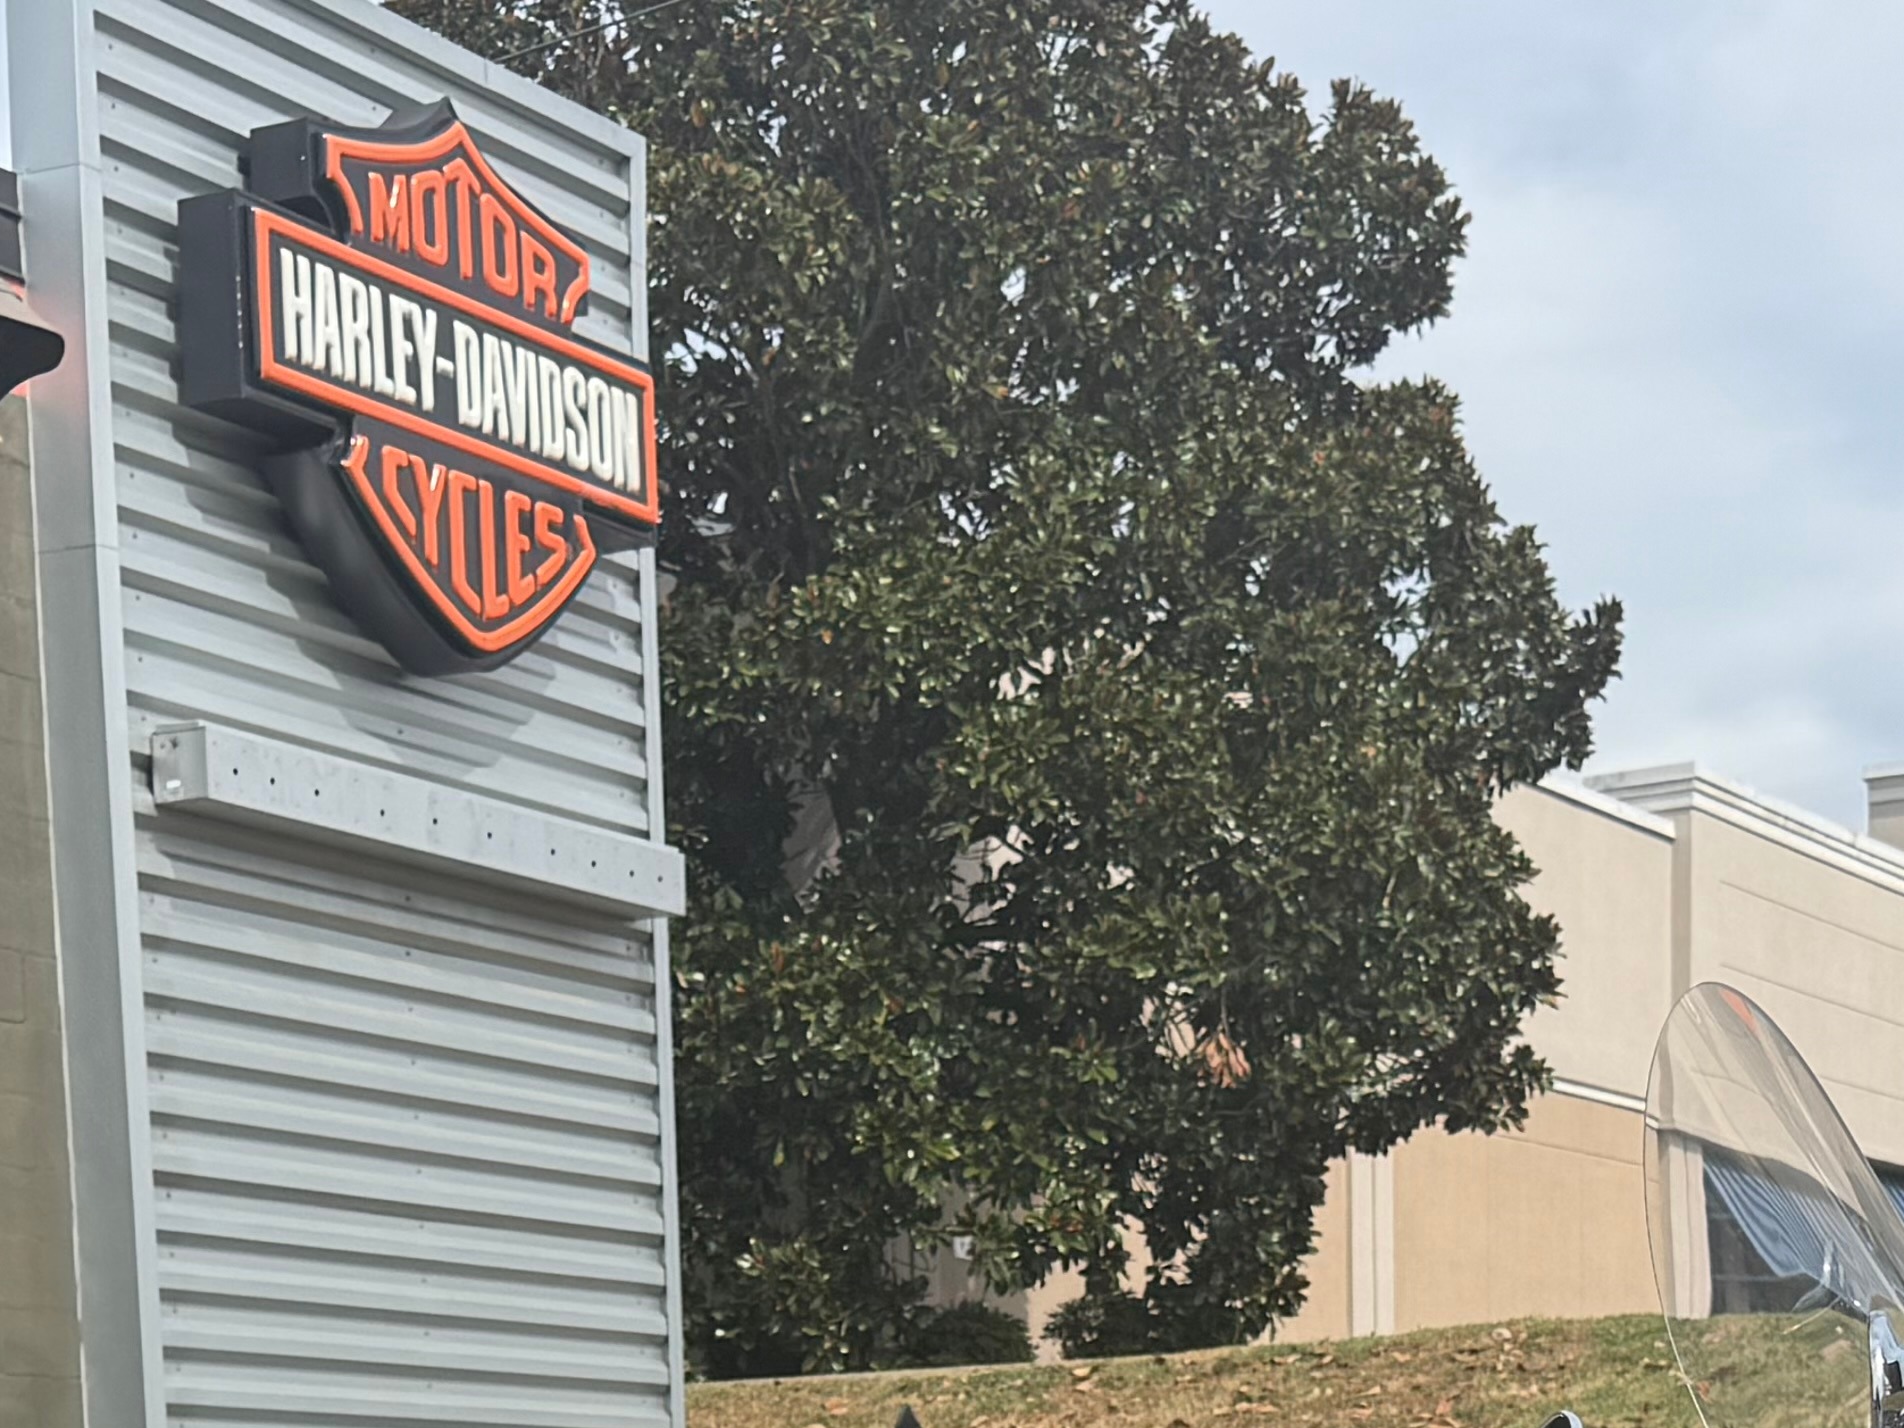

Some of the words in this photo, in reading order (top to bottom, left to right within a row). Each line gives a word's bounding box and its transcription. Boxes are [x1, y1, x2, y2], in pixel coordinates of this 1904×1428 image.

[368, 156, 559, 322] MOTOR
[279, 246, 642, 494] HARLEY-DAVIDSON
[380, 443, 568, 621] CYCLES
